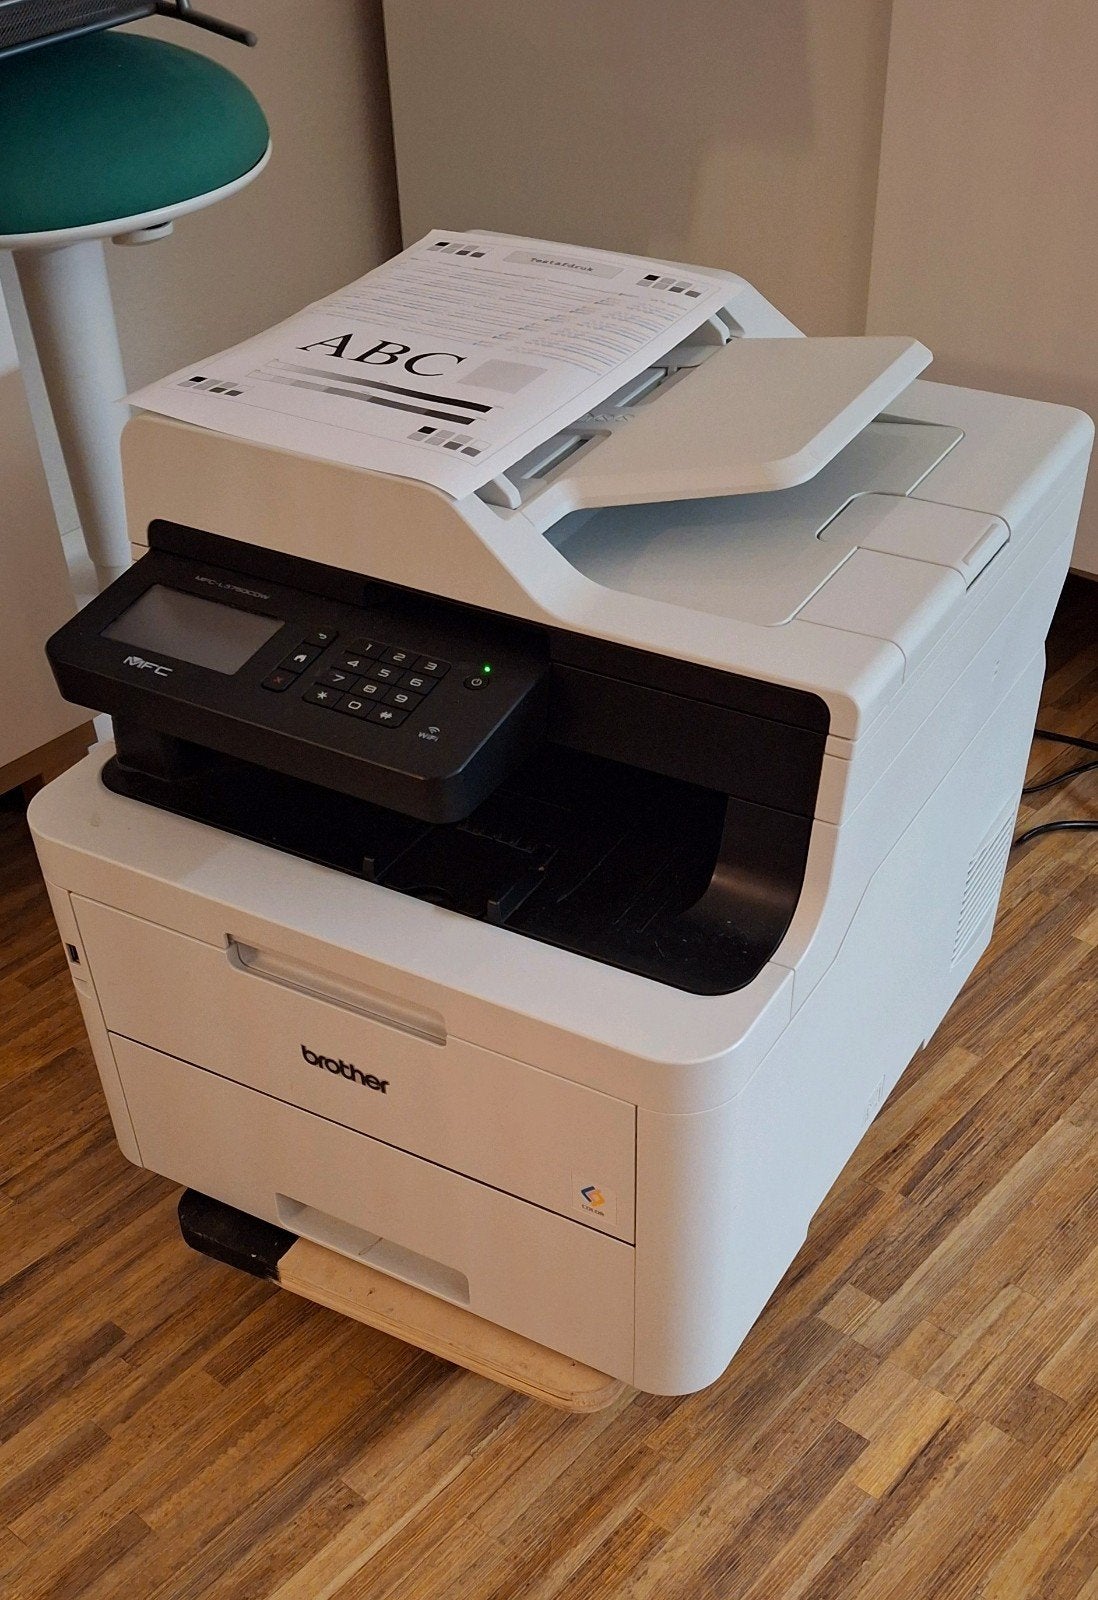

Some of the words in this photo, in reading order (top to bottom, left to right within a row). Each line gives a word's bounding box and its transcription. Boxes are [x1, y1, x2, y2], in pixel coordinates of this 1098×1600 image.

[296, 333, 467, 376] ABC
[123, 656, 173, 677] MFC
[365, 643, 373, 651] 1
[393, 652, 406, 661] 2
[424, 662, 437, 671] 3
[332, 673, 345, 682] 7
[363, 684, 377, 694] 8
[394, 694, 408, 703] 9
[347, 660, 359, 668] 4
[378, 669, 391, 678] 5
[410, 678, 424, 687] 6
[301, 1044, 390, 1094] brother
